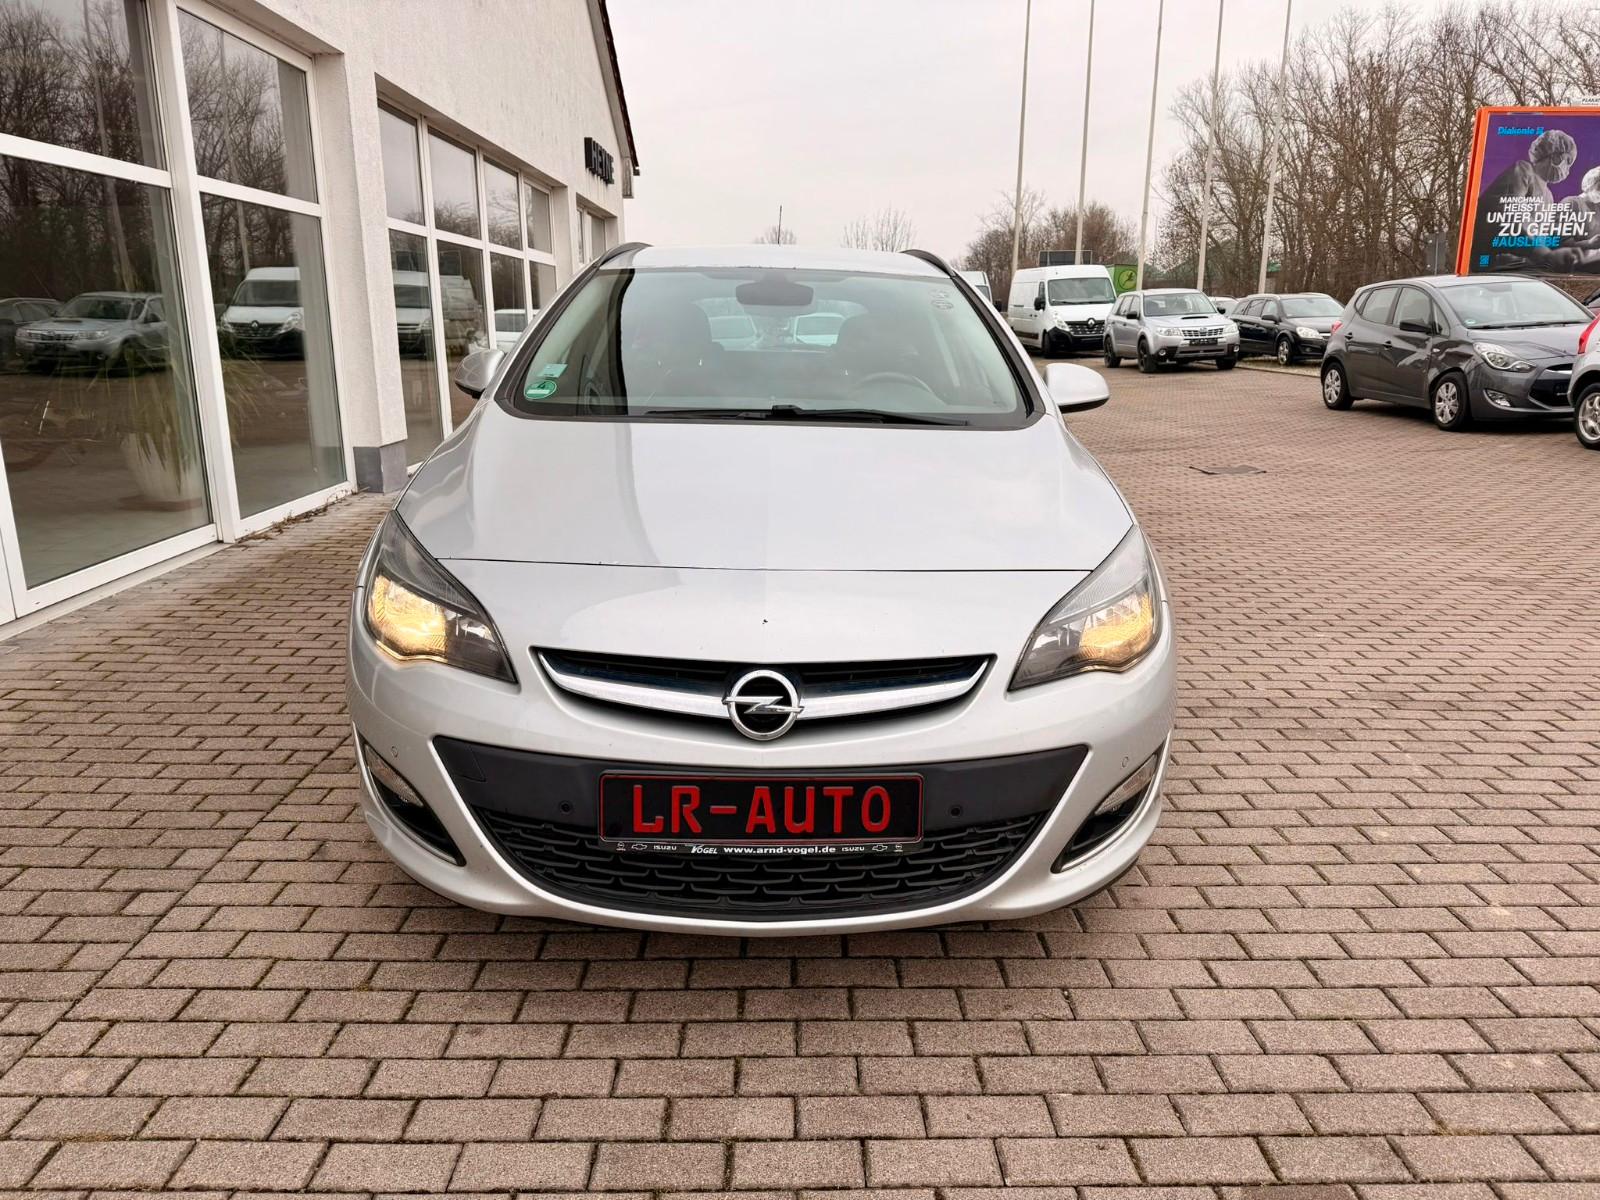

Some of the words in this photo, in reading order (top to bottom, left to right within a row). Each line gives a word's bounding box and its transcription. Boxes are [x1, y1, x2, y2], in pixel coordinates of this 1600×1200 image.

[1498, 127, 1534, 135] Diakonie
[1504, 203, 1539, 212] HEISST
[1487, 212, 1531, 223] UNTER
[1535, 212, 1556, 222] DIE
[1559, 212, 1595, 222] HAUT
[1498, 223, 1522, 236] ZU
[1526, 223, 1588, 236] GEHEN.
[1492, 236, 1560, 247] #AUSLIEBE
[632, 784, 891, 834] LR-AUTO
[723, 846, 836, 855] www.arnd-vogel.de
